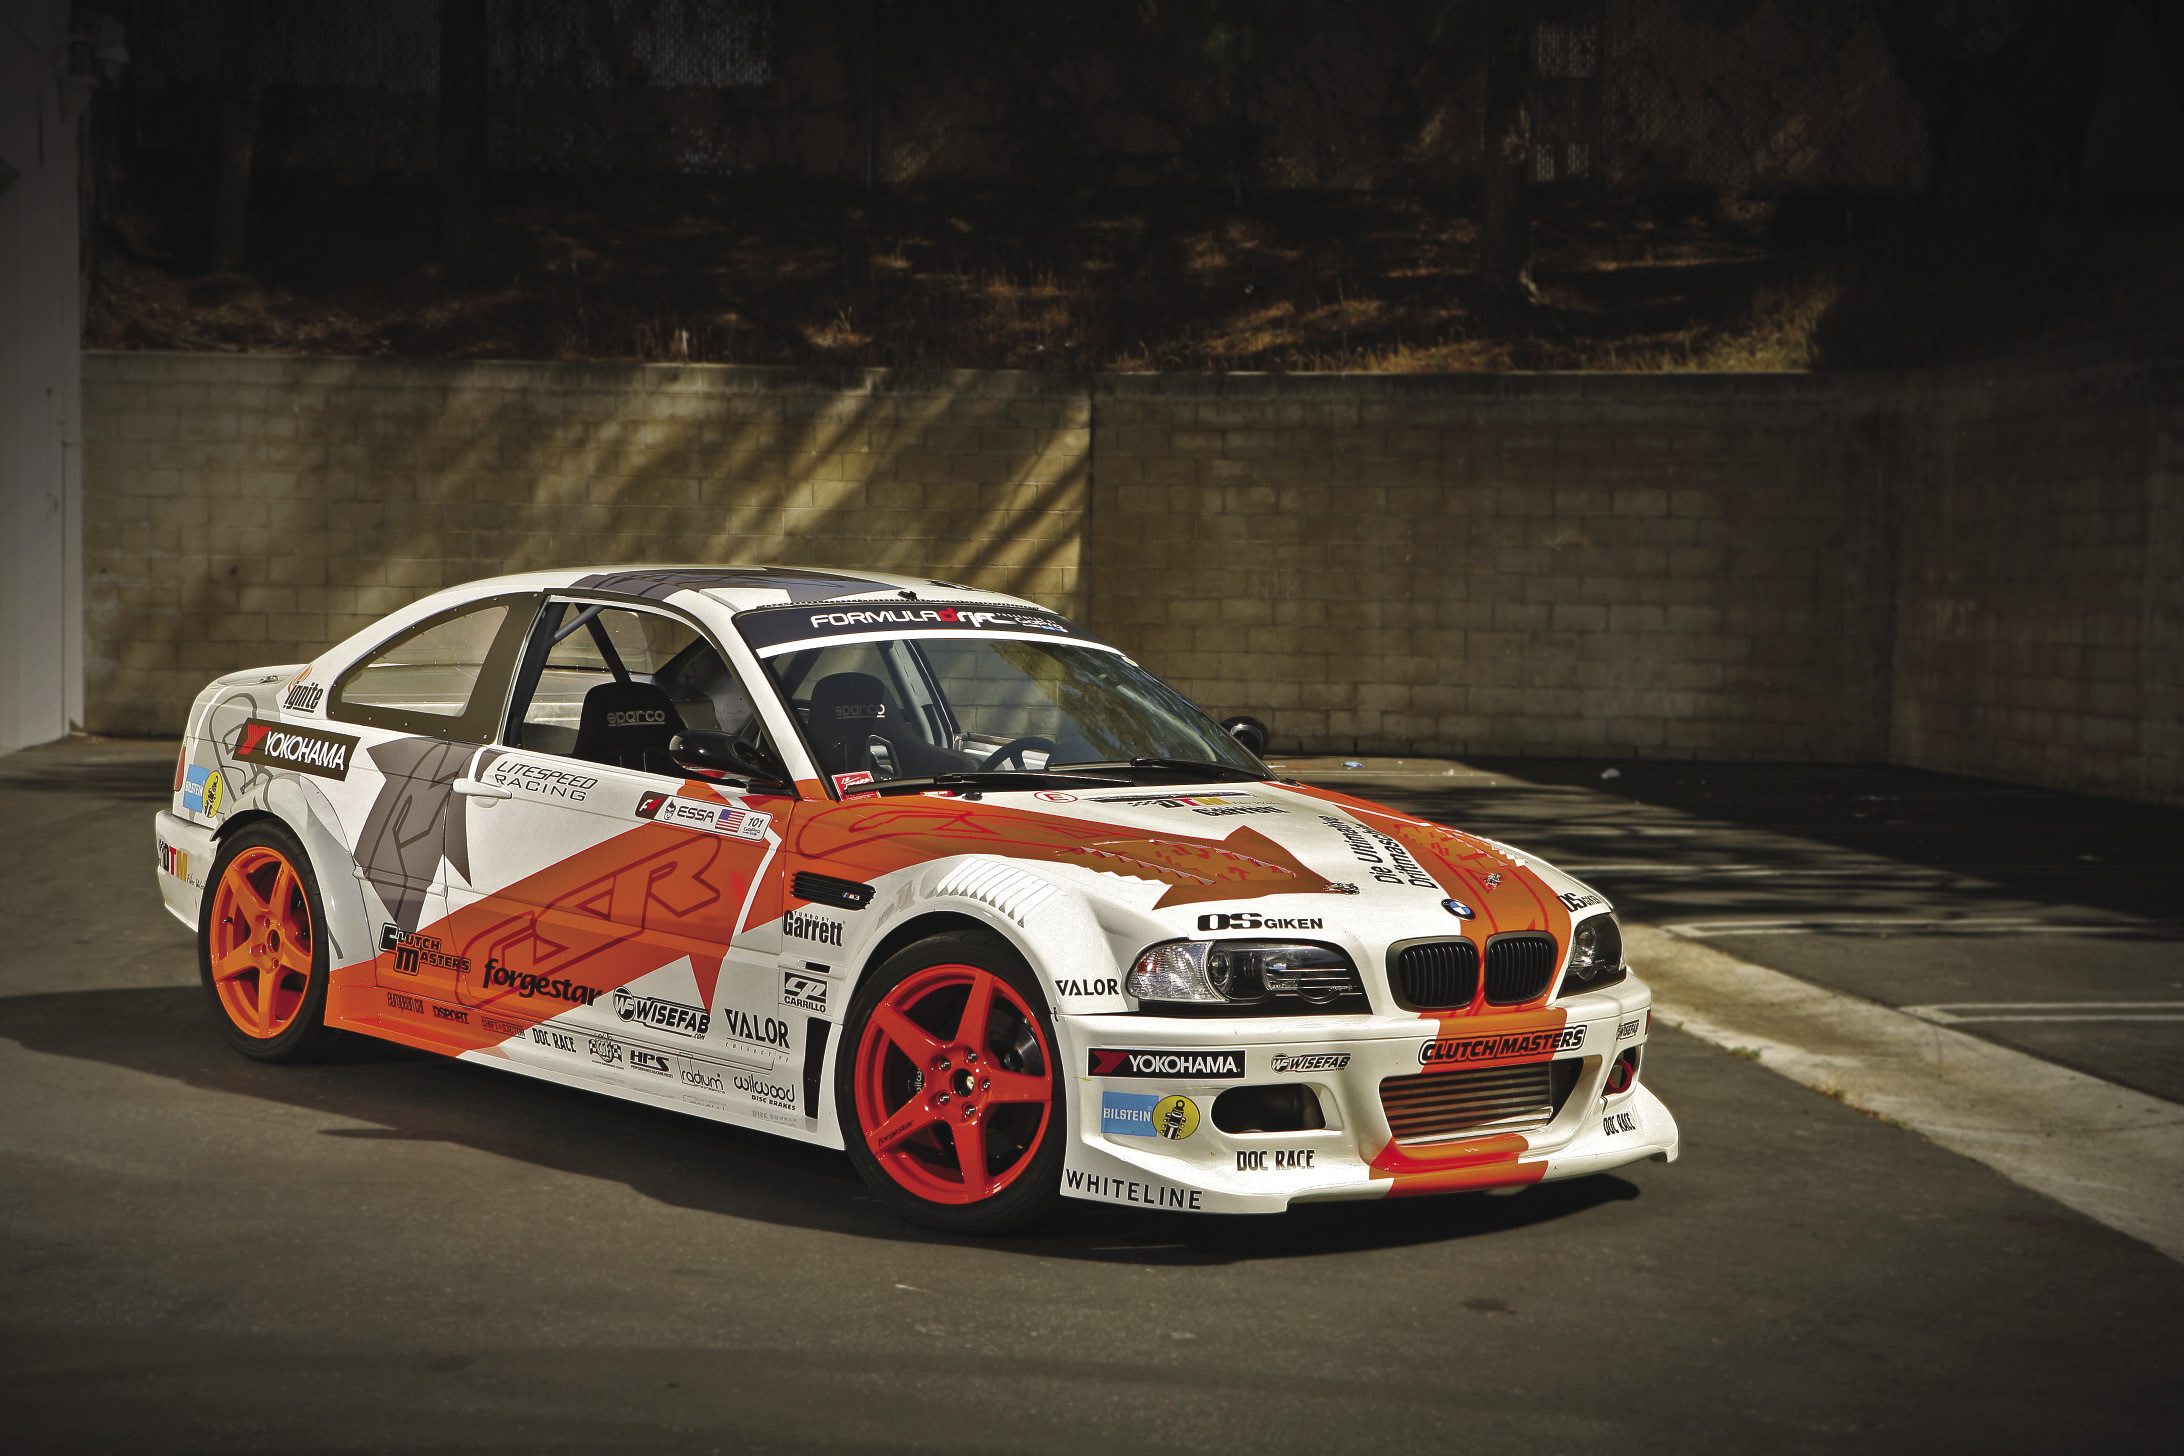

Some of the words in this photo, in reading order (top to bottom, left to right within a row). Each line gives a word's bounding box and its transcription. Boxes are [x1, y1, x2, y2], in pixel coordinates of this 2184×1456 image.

[283, 681, 324, 713] ignite
[606, 710, 666, 728] sparco
[835, 704, 886, 719] sparco
[264, 731, 347, 771] YOKOHAMA
[496, 760, 599, 790] LITESPEED
[494, 774, 589, 802] RACING
[1158, 797, 1231, 809] DTM
[677, 805, 715, 823] ESSA
[747, 817, 764, 828] 101
[1368, 866, 1405, 885] Die
[783, 910, 843, 947] Garrett
[1197, 913, 1263, 931] OS
[1264, 918, 1324, 929] GIKEN
[380, 922, 442, 952] CLUTCH
[394, 946, 471, 976] MASTERS
[482, 957, 603, 1006] forgestar
[1055, 978, 1119, 996] VALOR
[432, 1005, 469, 1024] DSPORT
[784, 995, 826, 1013] CARRILLO
[636, 999, 711, 1034] WISEFAB
[531, 1027, 551, 1047] DOC
[552, 1032, 577, 1053] RACE
[724, 1008, 791, 1050] VALOR
[1420, 1036, 1501, 1062] CLUTCH
[1501, 1028, 1584, 1056] MASTERS
[630, 1049, 670, 1072] HPS
[1128, 1054, 1238, 1073] YOKOHAMA
[1289, 1054, 1350, 1069] WISEFAB
[681, 1070, 724, 1090] radium
[733, 1074, 795, 1102] wilwood
[751, 1094, 767, 1103] DISC
[768, 1099, 796, 1111] BRAKES
[1104, 1107, 1151, 1122] BILSTEIN
[1236, 1150, 1268, 1171] DOC
[1275, 1149, 1316, 1170] RACE
[1066, 1168, 1203, 1210] WHITELINE
